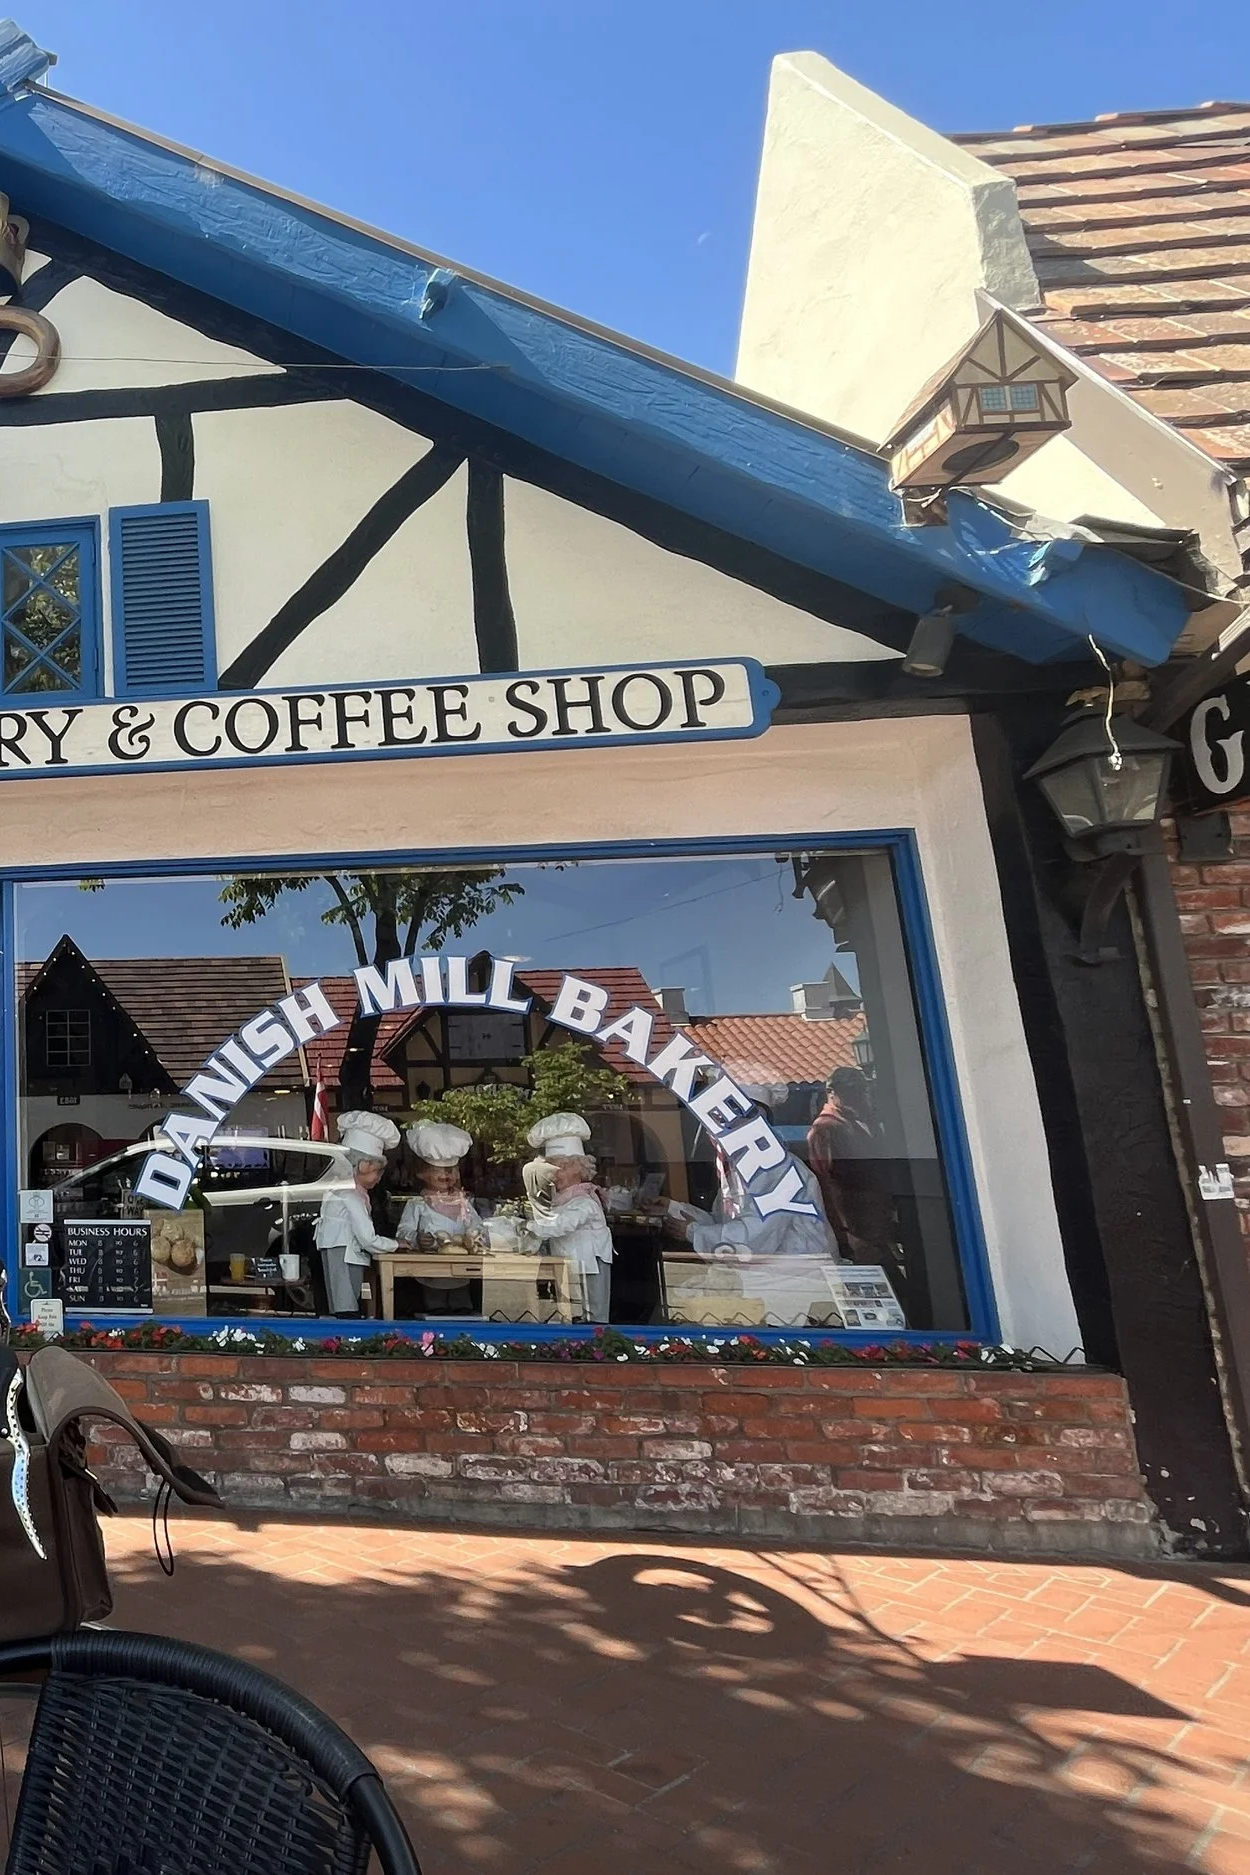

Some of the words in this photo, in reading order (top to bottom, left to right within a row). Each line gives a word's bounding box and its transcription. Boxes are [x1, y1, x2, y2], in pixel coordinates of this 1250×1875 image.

[107, 704, 153, 760] &
[174, 685, 482, 753] COFFEE
[506, 669, 726, 738] SHOP
[132, 979, 343, 1212] DANISH
[353, 955, 532, 1018] MILL
[546, 973, 826, 1221] BAKERY
[67, 1227, 110, 1236] BUSINESS
[113, 1227, 148, 1237] HOURS
[68, 1239, 88, 1247] MON
[68, 1257, 87, 1265] WED
